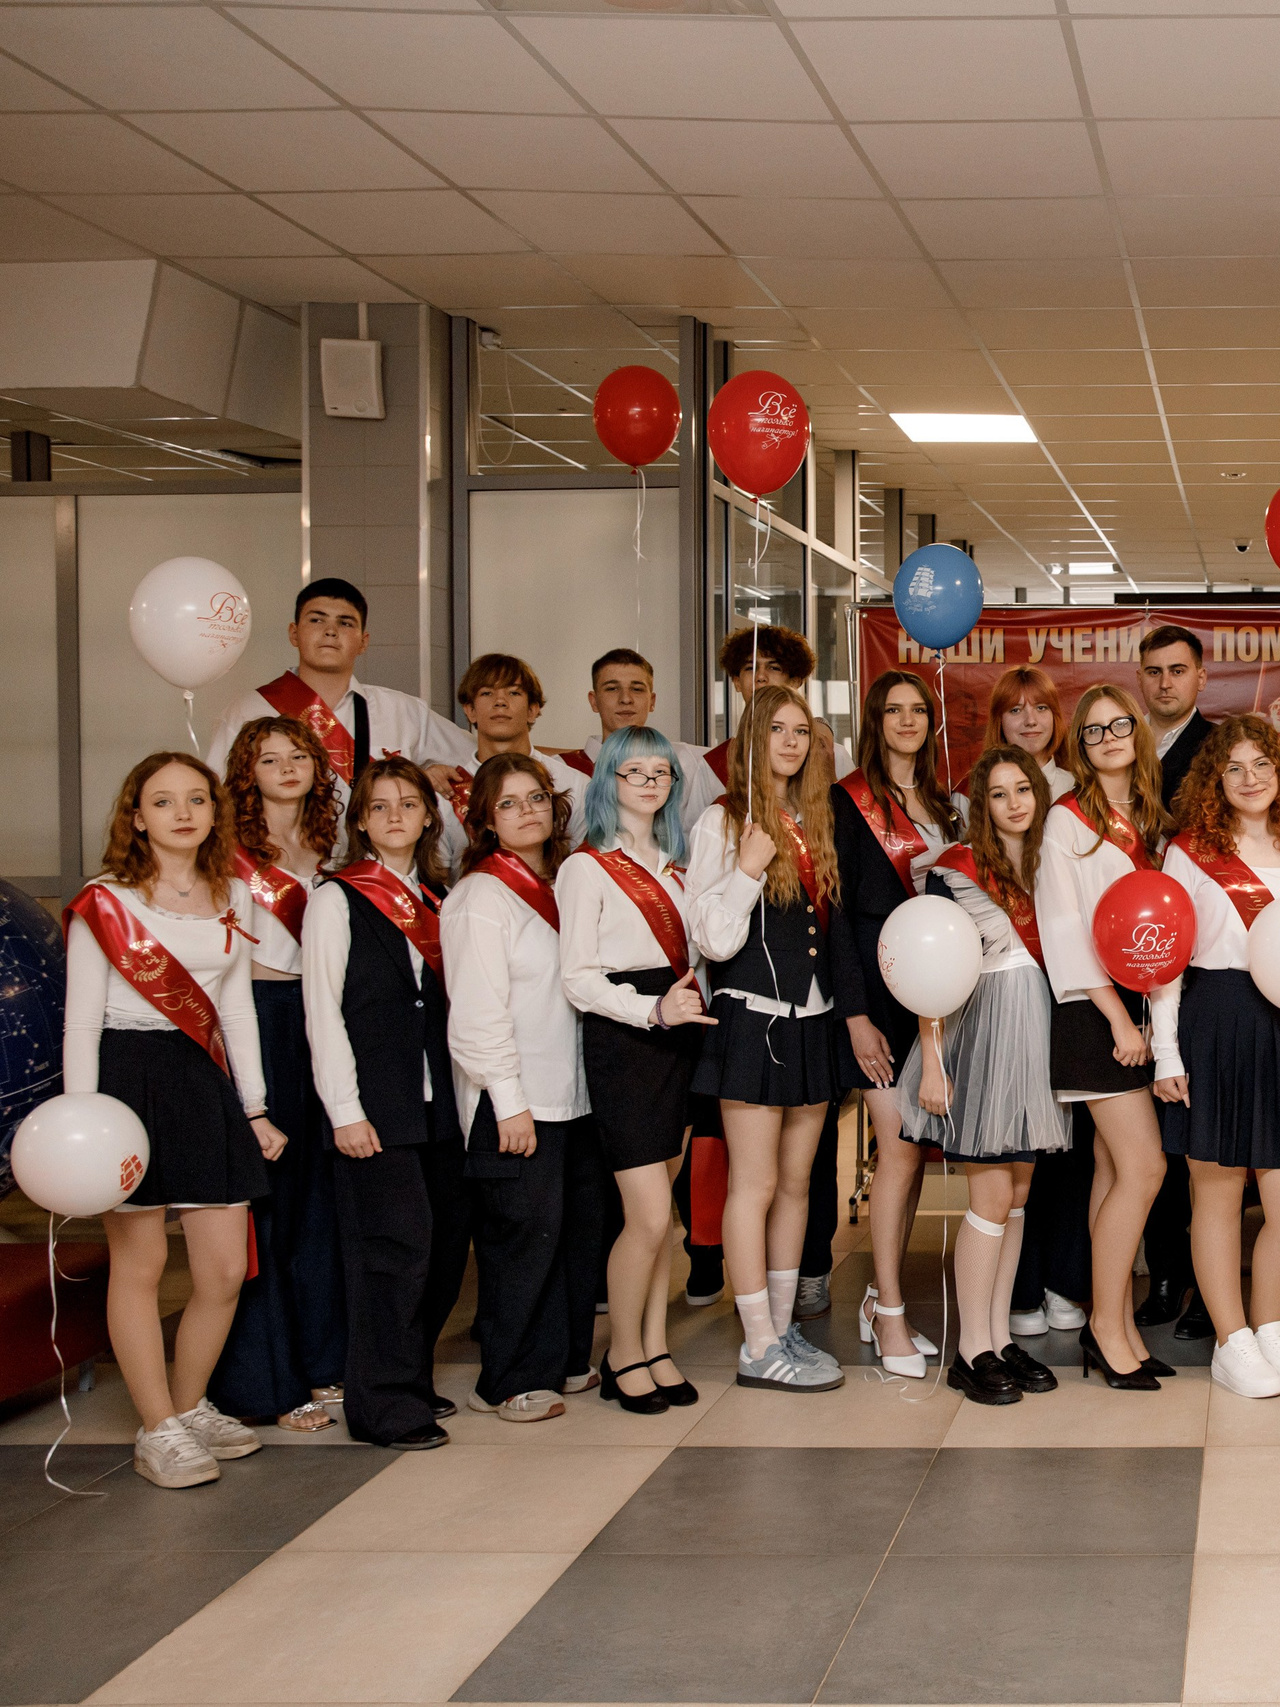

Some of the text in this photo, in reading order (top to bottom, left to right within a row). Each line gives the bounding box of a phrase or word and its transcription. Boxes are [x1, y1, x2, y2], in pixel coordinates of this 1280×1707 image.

[748, 390, 798, 419] Всё
[1027, 626, 1189, 664] УЧЕНИ
[1121, 922, 1178, 953] Всё
[1132, 949, 1171, 961] только
